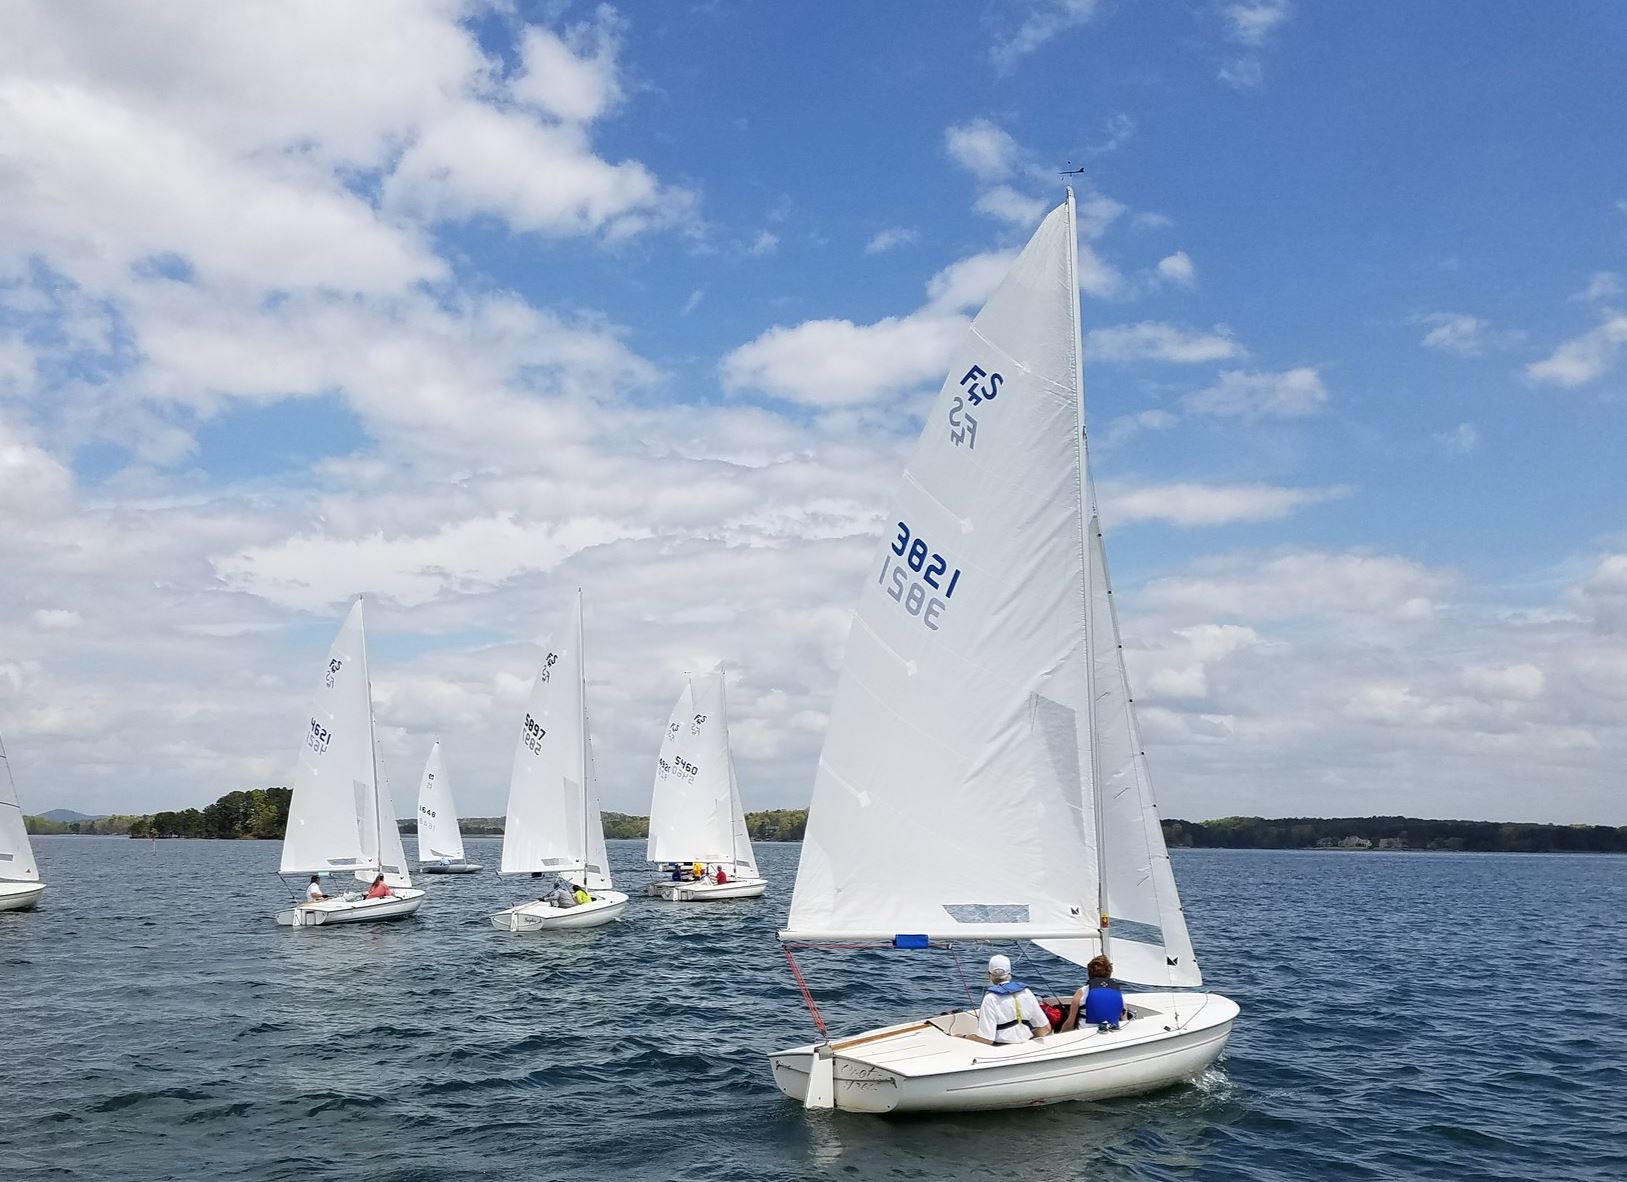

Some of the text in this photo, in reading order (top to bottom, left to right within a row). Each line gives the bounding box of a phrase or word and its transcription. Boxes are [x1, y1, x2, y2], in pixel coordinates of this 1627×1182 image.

[960, 364, 1003, 405] FS
[891, 521, 961, 598] 3821
[311, 717, 331, 745] 4621
[525, 713, 546, 740] 5897
[675, 755, 698, 776] 5460
